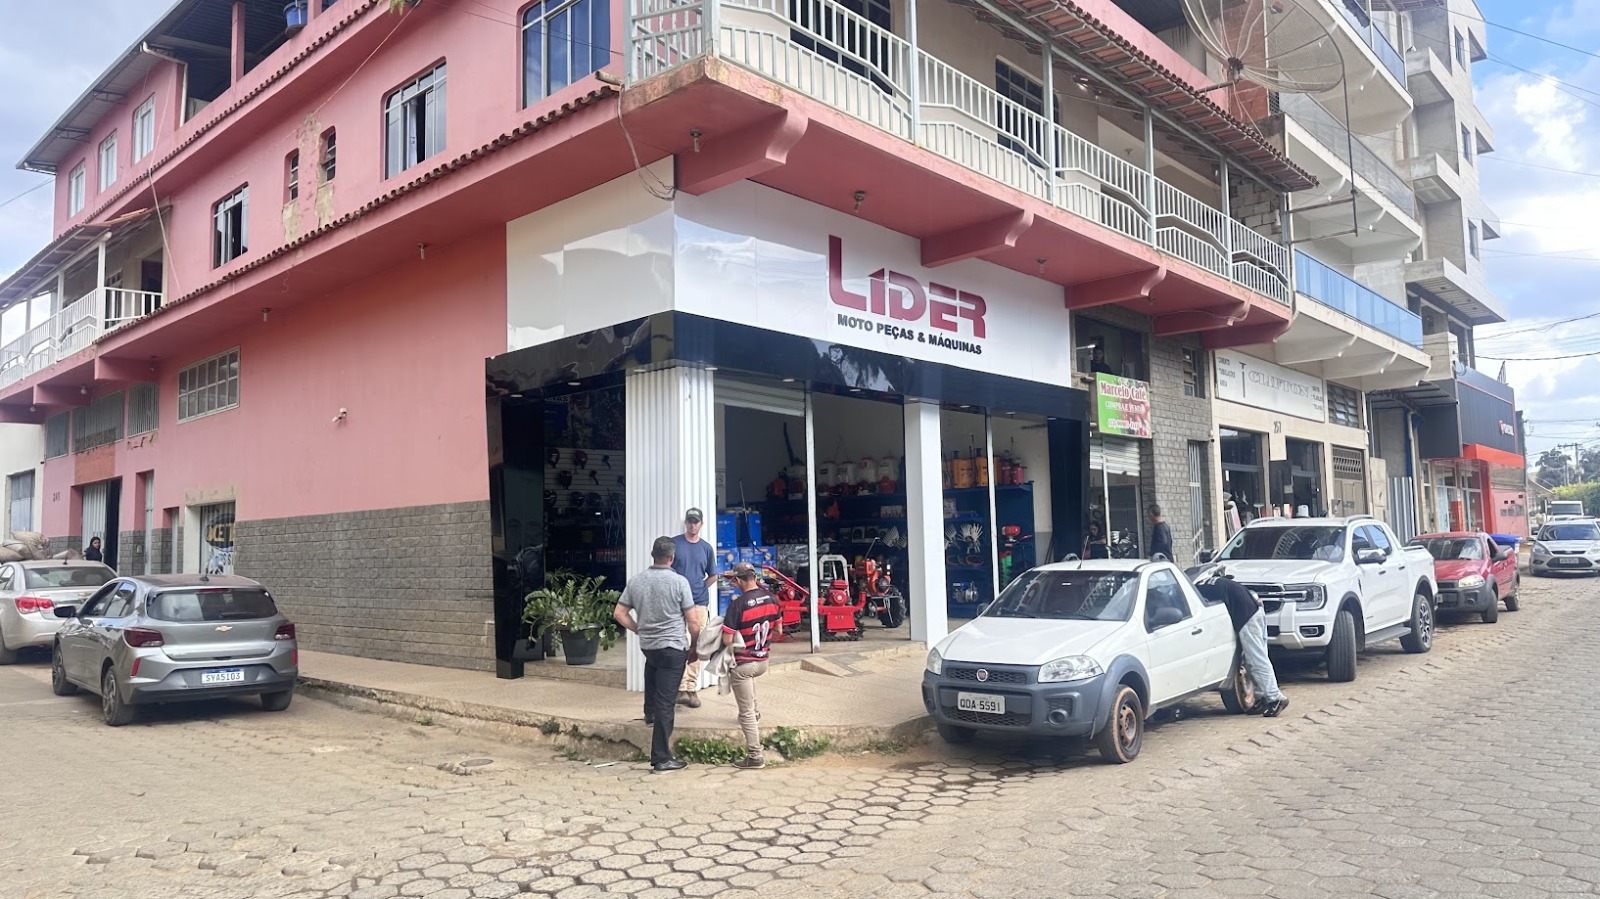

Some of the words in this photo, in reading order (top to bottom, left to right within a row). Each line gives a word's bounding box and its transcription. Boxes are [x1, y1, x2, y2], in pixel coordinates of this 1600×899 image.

[837, 313, 874, 332] MOTO
[876, 323, 914, 341] PEÇAS
[917, 332, 926, 343] &
[928, 332, 982, 355] MÁQUINAS
[1100, 381, 1130, 398] Marcelo
